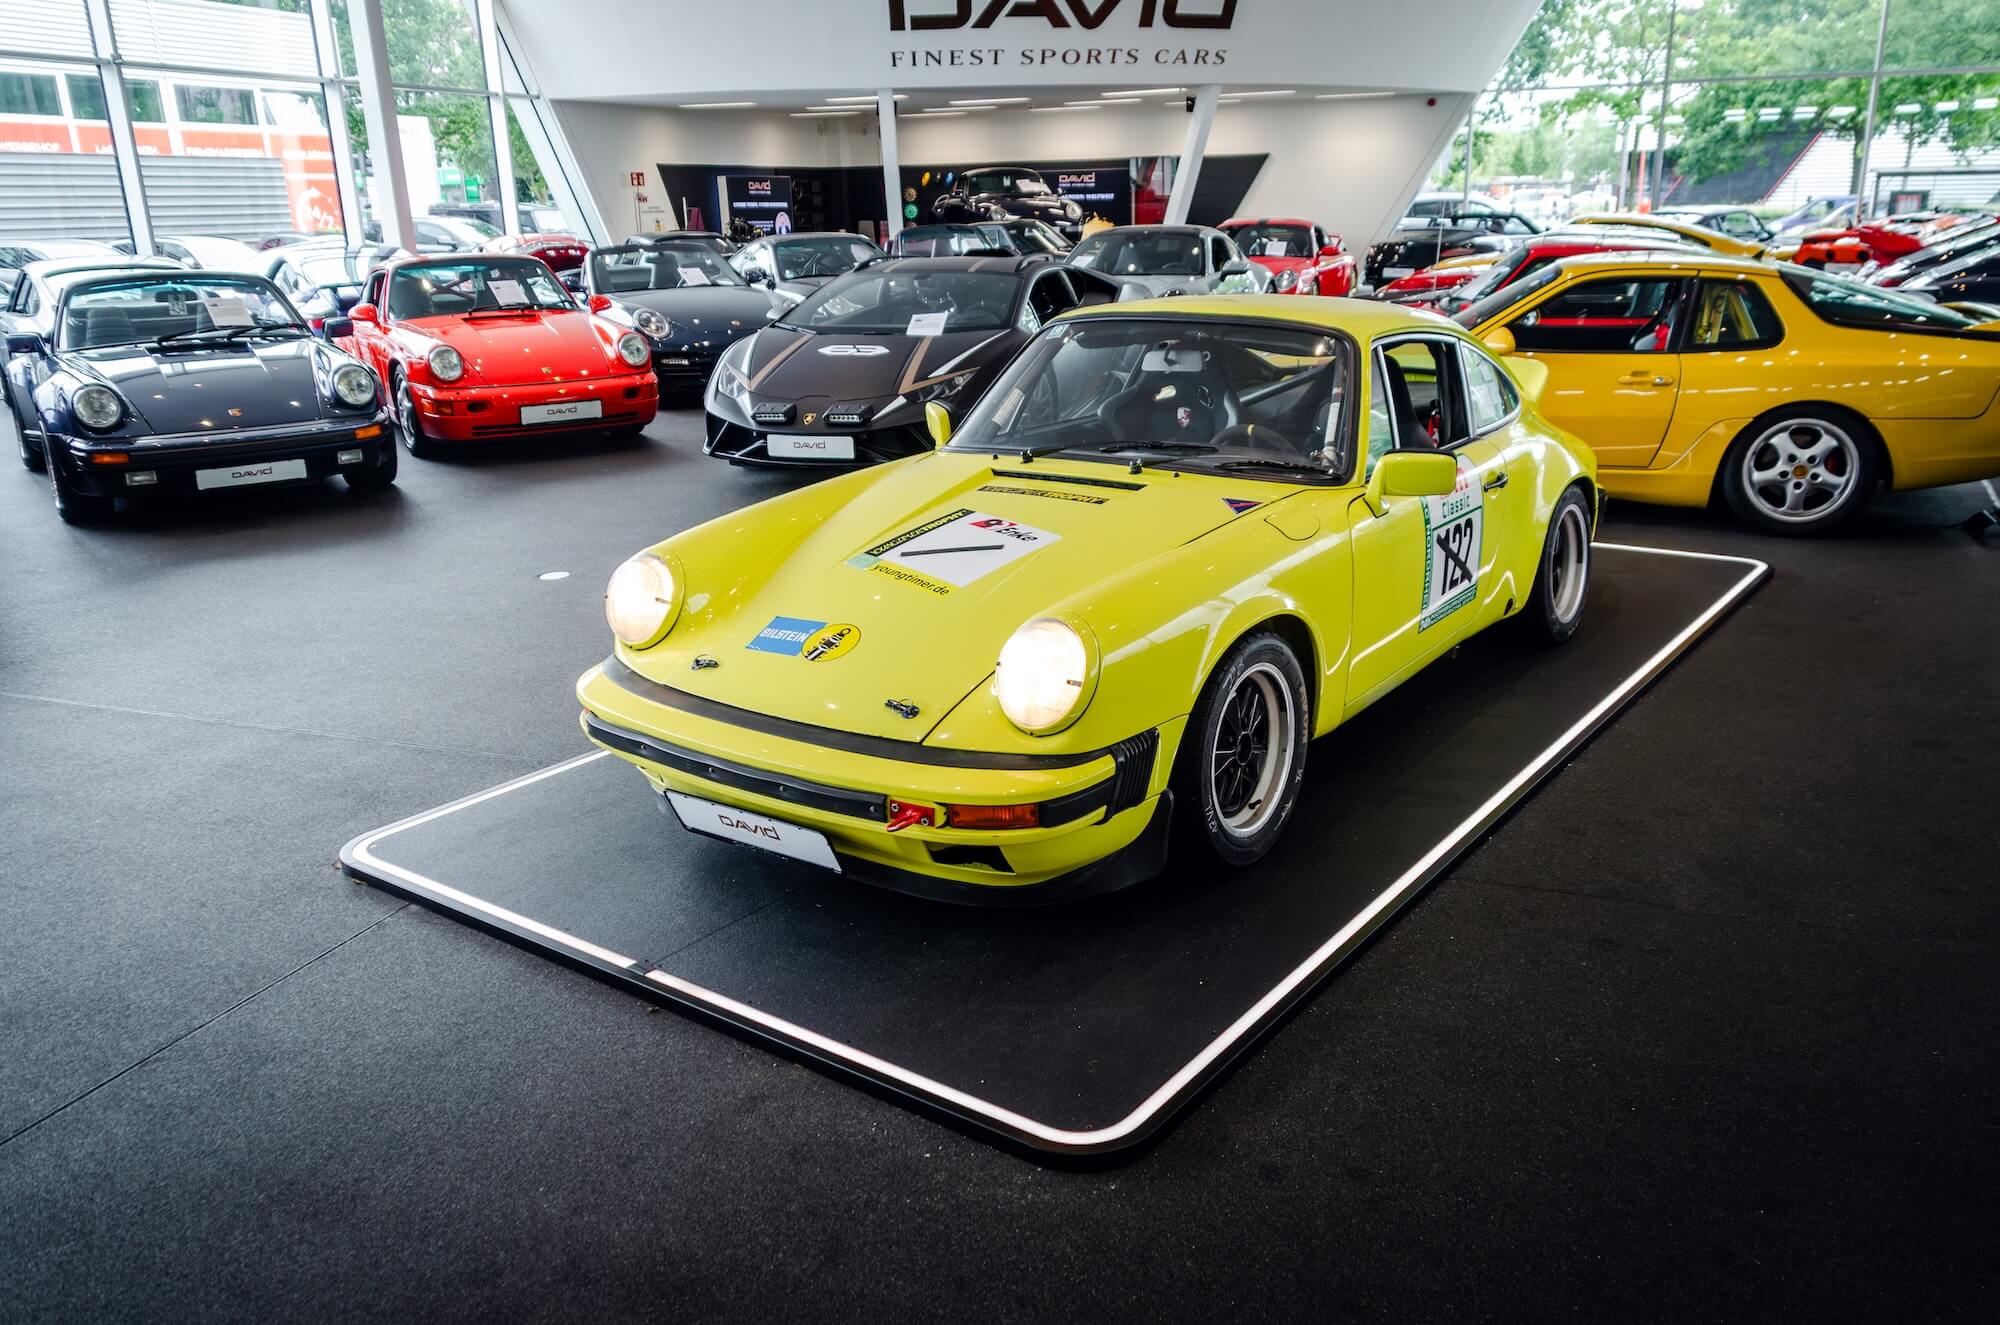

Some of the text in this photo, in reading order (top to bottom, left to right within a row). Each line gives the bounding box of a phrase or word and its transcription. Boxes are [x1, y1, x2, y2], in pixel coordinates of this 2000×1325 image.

[891, 49, 1227, 68] FINEST SPORTS CARS
[1442, 492, 1470, 519] Classic
[871, 562, 950, 596] youngtimer.de
[760, 628, 810, 643] BILSTEIN
